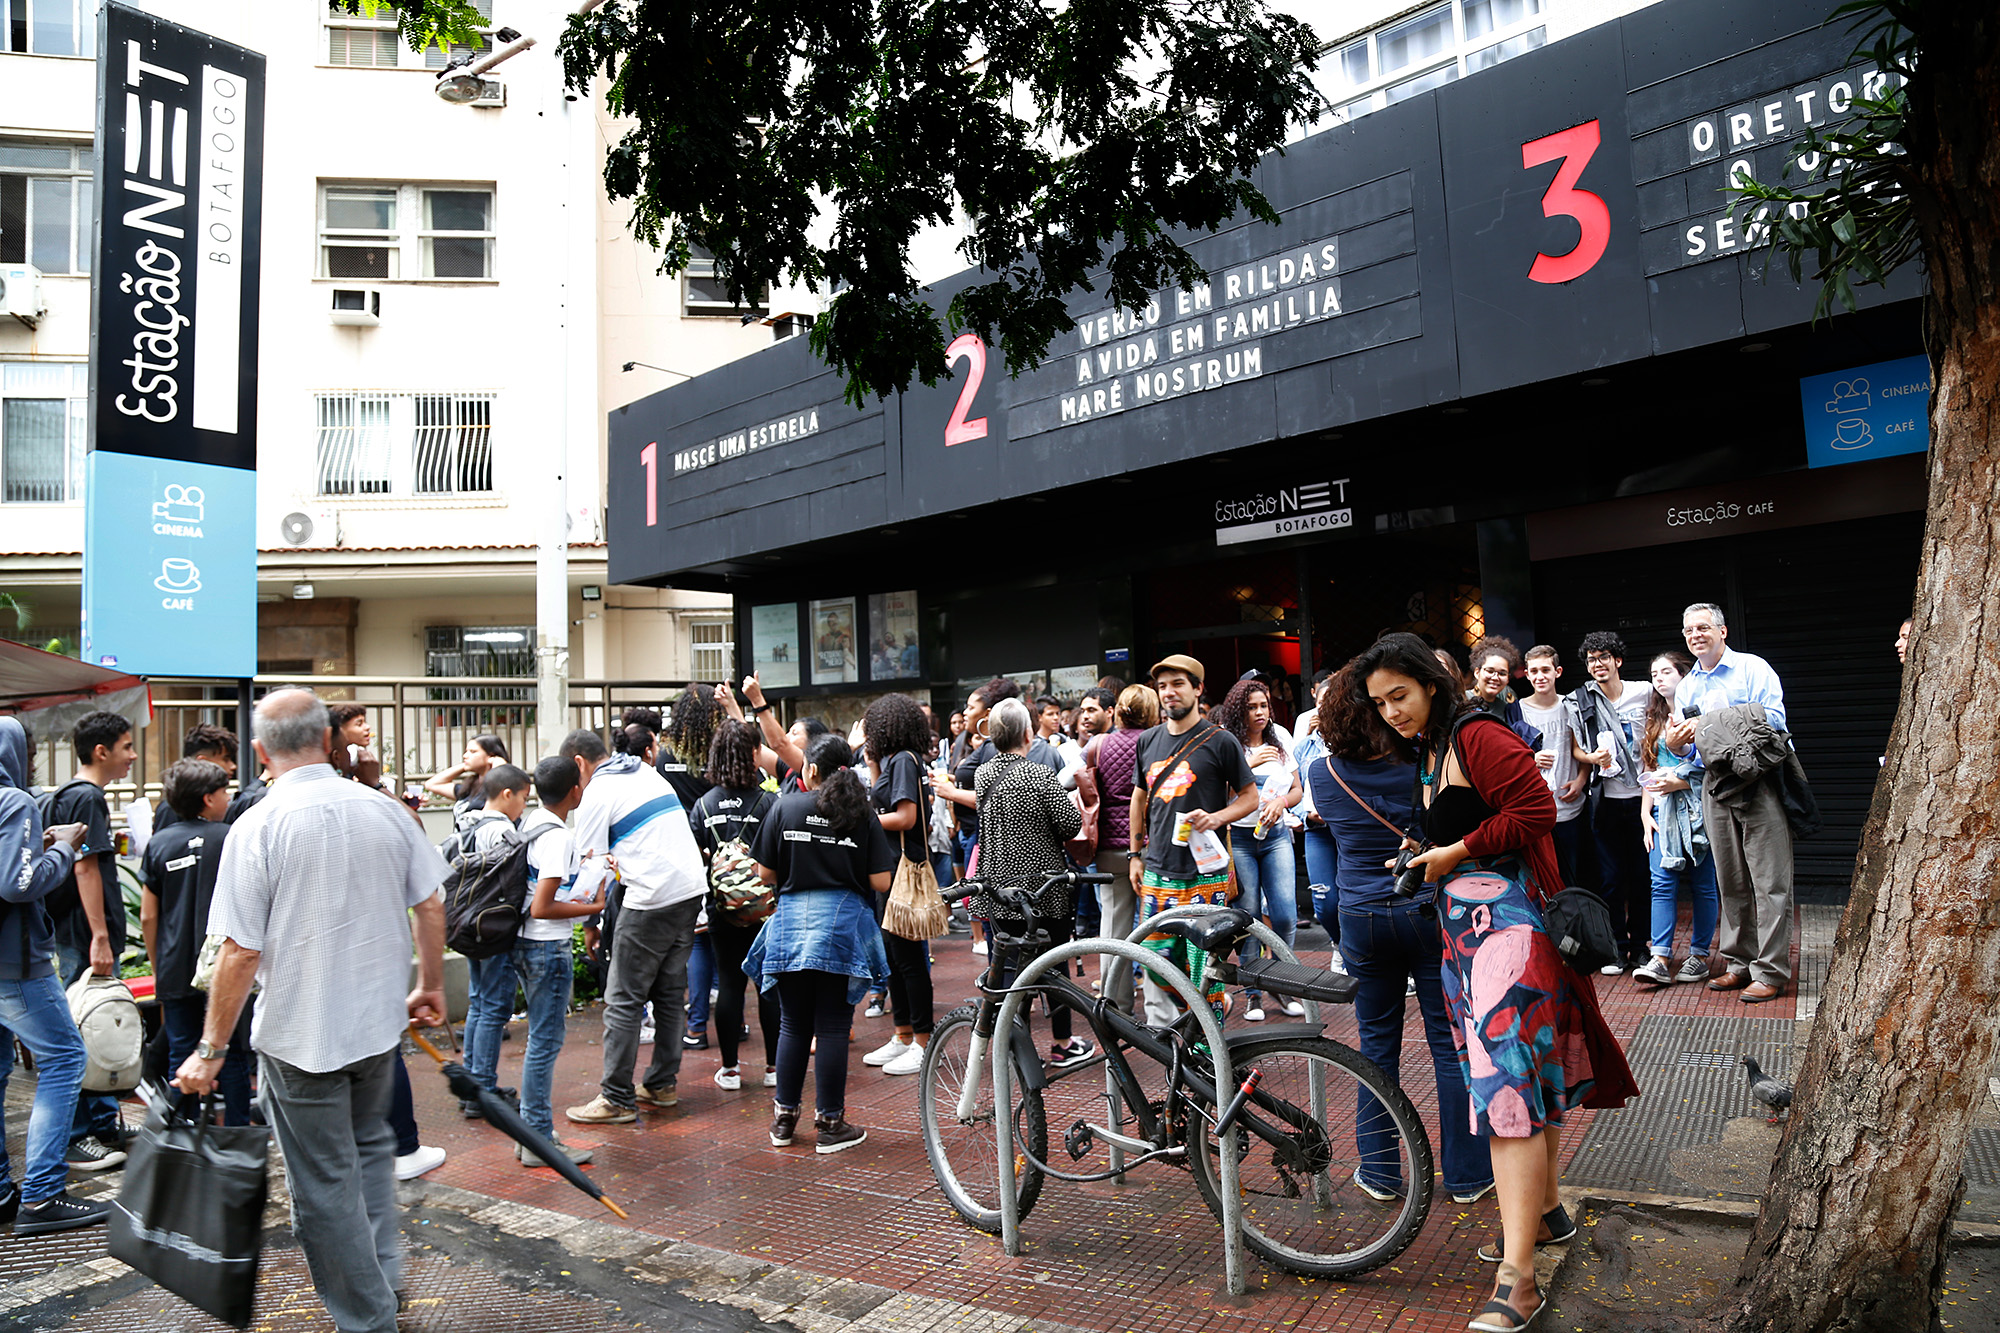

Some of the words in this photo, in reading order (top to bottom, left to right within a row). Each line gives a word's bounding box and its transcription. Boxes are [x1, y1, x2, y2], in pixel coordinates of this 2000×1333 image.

[122, 39, 190, 239] NET
[1692, 120, 1715, 153] O
[208, 78, 237, 266] BOTAFOGO
[1521, 118, 1611, 284] 3
[1178, 284, 1212, 315] EM
[1226, 244, 1336, 300] RILDAS
[115, 238, 190, 424] Estação
[1077, 358, 1092, 382] A
[1098, 338, 1158, 375] VIDA
[1171, 323, 1204, 354] EM
[1215, 286, 1341, 342] FAMILIA
[945, 333, 988, 447] 2
[1061, 380, 1122, 422] MARÉ
[1136, 347, 1262, 399] NOSTRUM
[1881, 382, 1930, 399] CINEMA
[674, 443, 715, 472] NASCE
[719, 432, 746, 458] UMA
[749, 411, 819, 449] ESTRELA
[1885, 419, 1915, 435] CAFÉ
[640, 441, 657, 527] 1
[1215, 493, 1278, 523] Estação
[1279, 478, 1350, 513] NET
[1666, 501, 1742, 527] Estação
[1746, 500, 1775, 516] CAFÉ
[153, 523, 204, 538] CINEMA
[1275, 511, 1350, 534] BOTAFOGO
[162, 596, 194, 611] CAFÉ
